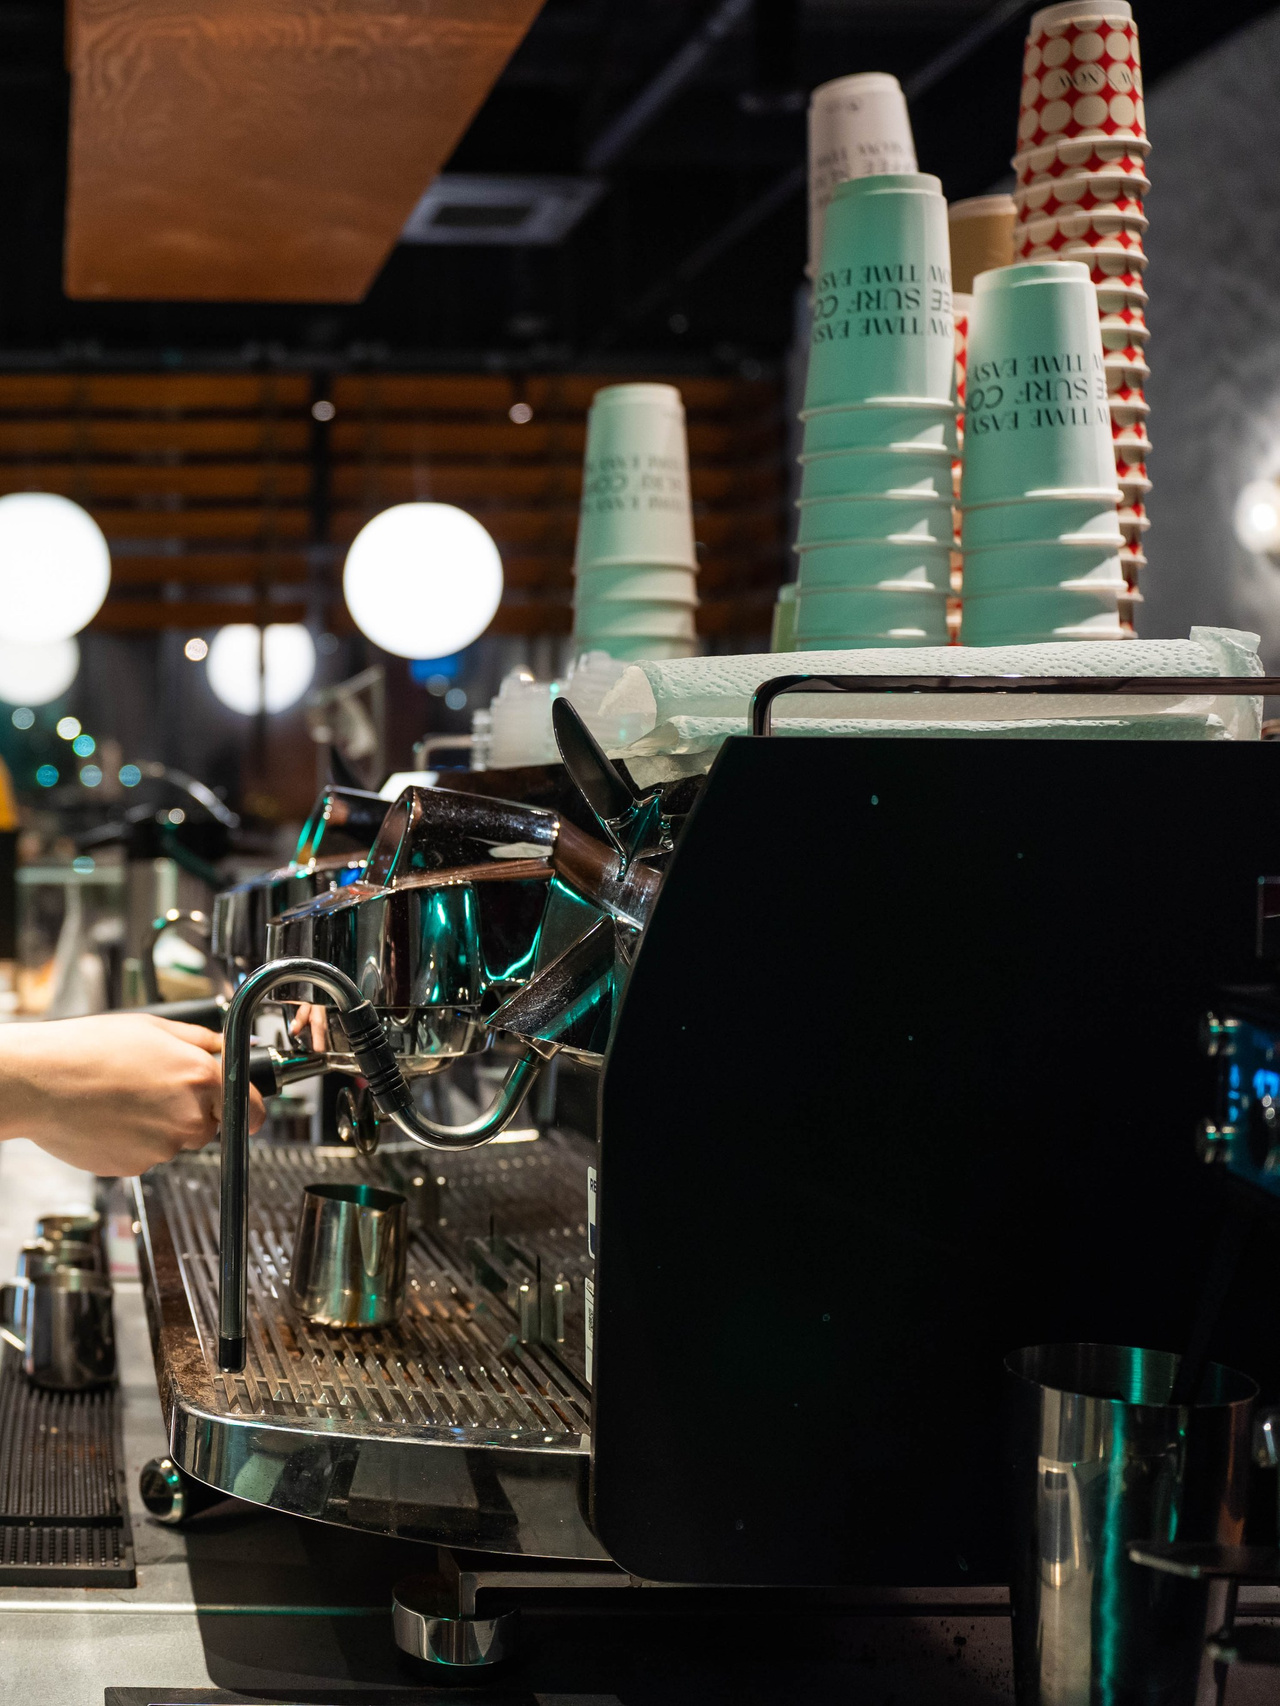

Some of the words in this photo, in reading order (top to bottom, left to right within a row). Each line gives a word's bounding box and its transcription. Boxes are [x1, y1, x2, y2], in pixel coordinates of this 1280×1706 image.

[860, 264, 920, 285] TIME
[846, 288, 921, 314] SURF
[859, 316, 923, 337] TIME
[1028, 353, 1084, 375] TIME
[1015, 377, 1089, 405] SURF
[1031, 407, 1091, 428] TIME
